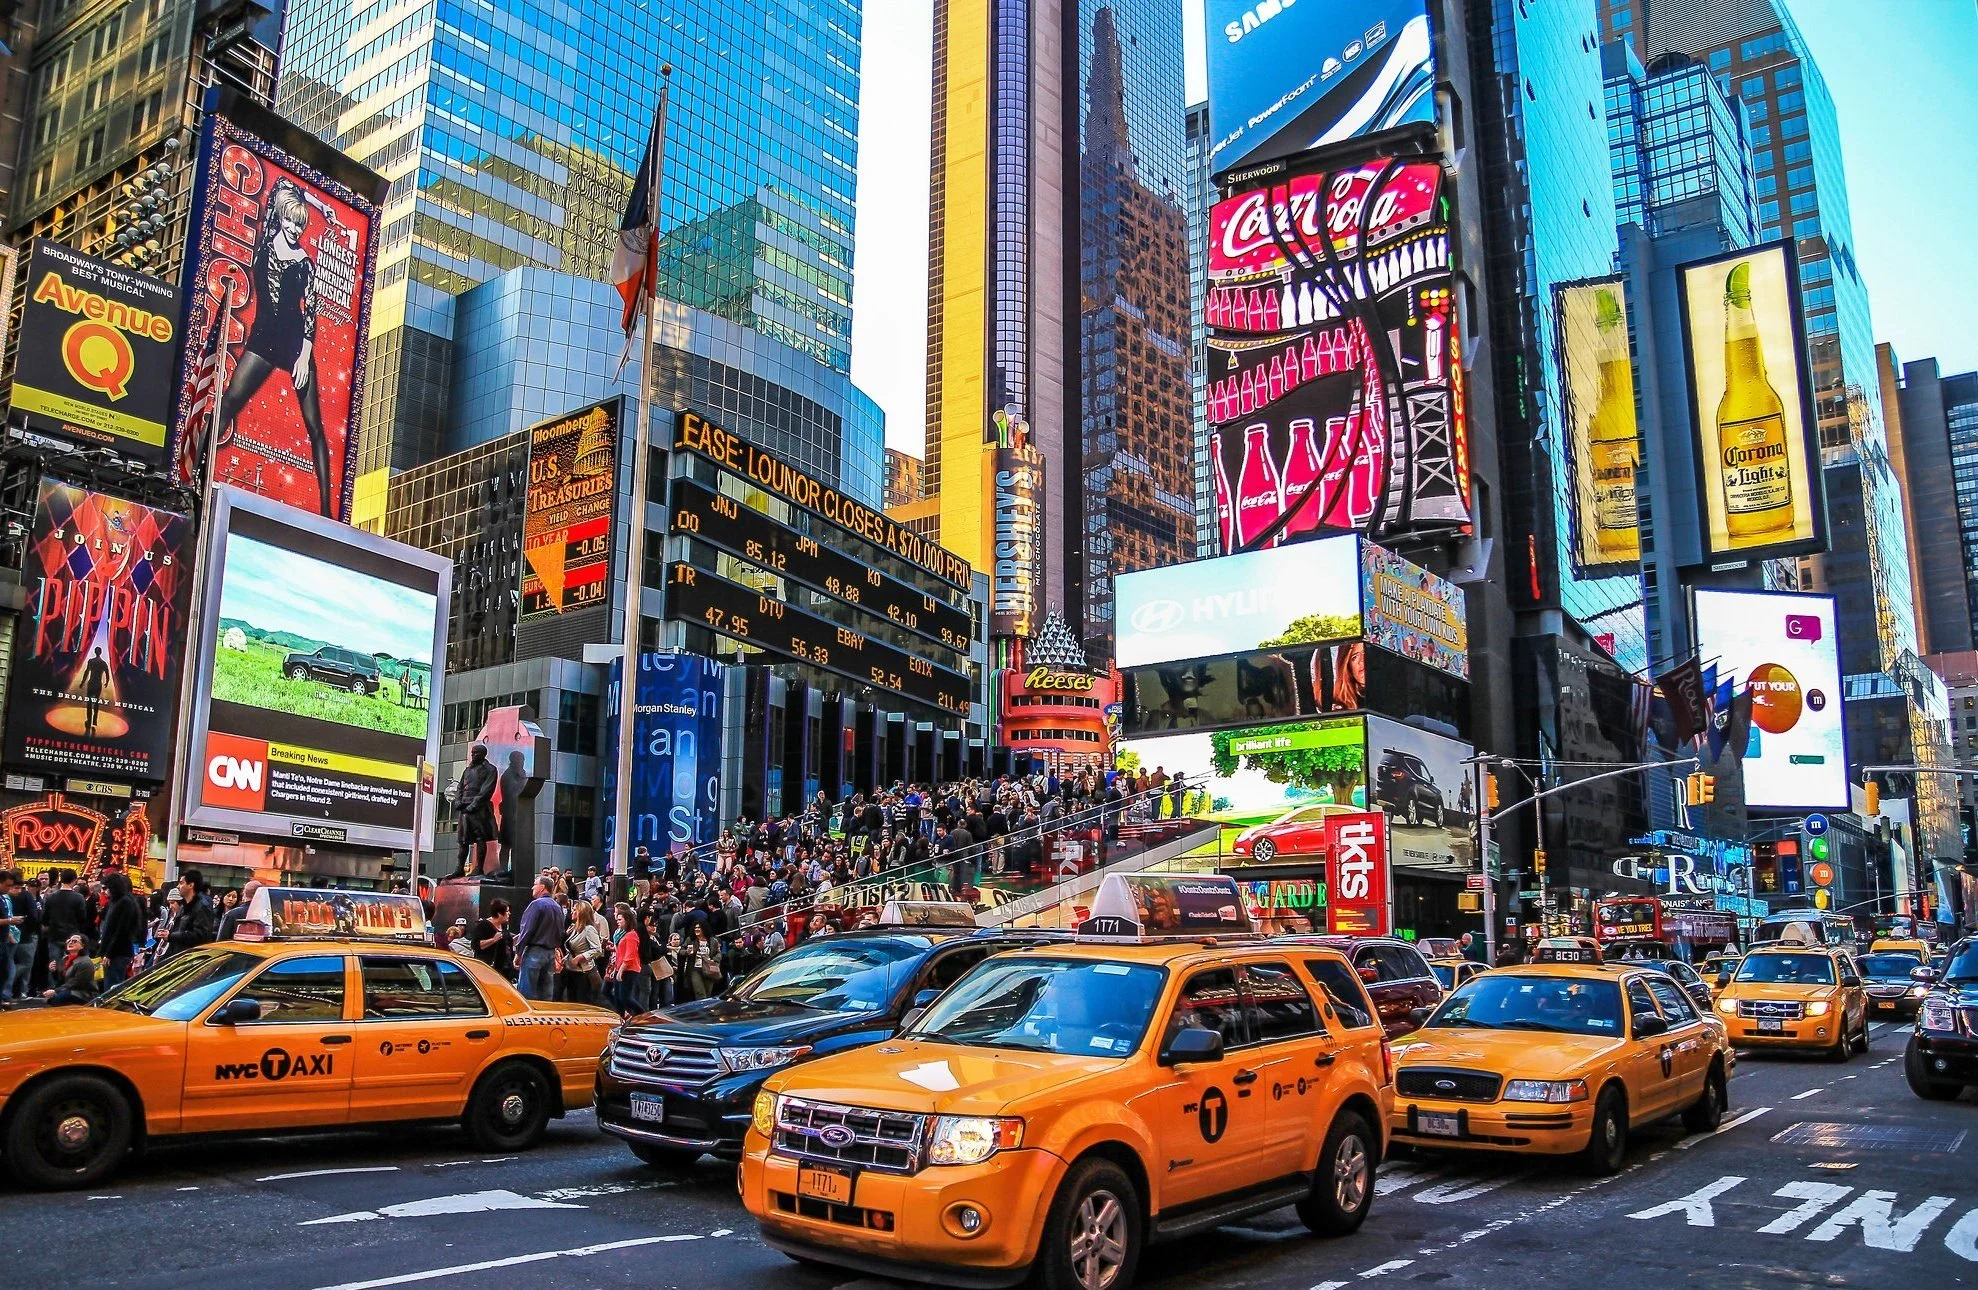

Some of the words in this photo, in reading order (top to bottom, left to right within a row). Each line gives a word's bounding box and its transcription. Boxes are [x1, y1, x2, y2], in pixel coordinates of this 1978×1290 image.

[1227, 164, 1280, 183] SHERWOOD
[43, 246, 104, 275] BROADWAY'S
[317, 250, 356, 283] RUNNING
[72, 266, 98, 281] BEST
[101, 277, 145, 298] MUSICAL
[313, 278, 351, 309] MUSICAL
[315, 264, 356, 295] AMERICAN
[34, 272, 173, 343] Avenue
[62, 319, 135, 402] Q
[40, 404, 96, 425] TELECHARGE.COM
[1449, 335, 1470, 499] SQUARE
[61, 424, 115, 443] AVENUEQ.COM
[533, 414, 591, 445] Bloomberg
[531, 455, 561, 484] U.S.
[1723, 442, 1786, 469] Corona
[675, 413, 743, 472] EASE:
[748, 447, 821, 513] LOUNOR
[824, 489, 884, 544] CLOSES
[886, 523, 897, 552] A
[1737, 465, 1774, 487] Light
[529, 472, 614, 513] TREASURIES
[549, 510, 569, 526] YIELD
[576, 498, 610, 517] CHANGE
[54, 529, 124, 555] JOIN
[143, 550, 173, 566] US
[576, 535, 605, 555] -0.05
[995, 467, 1033, 612] HERSHEY'S
[711, 494, 737, 520] JNJ
[746, 538, 787, 572] 85.12
[796, 534, 818, 558] JPM
[825, 575, 860, 604] 48.88
[867, 567, 881, 587] KO
[887, 603, 917, 630] 42.10
[923, 595, 936, 614] LH
[940, 628, 969, 651] 93.67
[573, 581, 602, 601] -0.04
[1379, 576, 1403, 603] MAKE
[1404, 588, 1412, 606] A
[1411, 590, 1446, 622] PLAYDATE
[28, 576, 170, 682] PIPPIN
[1381, 594, 1403, 620] WITH
[1404, 606, 1422, 630] YOUR
[1424, 615, 1441, 638] OWN
[1443, 623, 1461, 646] KIDS.
[1789, 620, 1803, 634] G
[704, 606, 749, 638] 47.95
[759, 595, 785, 621] DTV
[791, 637, 829, 666] 56.33
[837, 627, 865, 652] EBAY
[871, 666, 902, 692] 52.54
[909, 654, 933, 679] EQIX
[938, 691, 970, 716] 211.49
[1024, 666, 1095, 690] Reese's
[1767, 681, 1796, 692] YOUR
[33, 688, 53, 697] THE
[57, 692, 110, 706] BROADWAY
[114, 701, 155, 713] MUSICAL
[663, 703, 697, 717] Stanley
[1813, 696, 1823, 705] m
[25, 746, 91, 760] TELECHARGE.COM
[30, 754, 53, 762] MUSIC
[271, 747, 306, 763] Breaking
[306, 753, 329, 765] News
[1235, 737, 1273, 752] brilliant
[1274, 737, 1292, 748] life
[208, 754, 263, 792] CNN
[272, 769, 289, 780] Manti
[306, 775, 323, 786] Notre
[323, 778, 340, 788] Dame
[340, 780, 369, 793] linebacker
[370, 784, 393, 796] involved
[393, 788, 398, 797] in
[398, 788, 412, 799] hoax
[95, 784, 113, 793] CBS
[271, 789, 299, 803] Chargers
[300, 793, 306, 801] in
[325, 796, 332, 805] 2.
[272, 779, 285, 789] that
[285, 782, 310, 793] included
[310, 785, 344, 798] nonexistent
[344, 790, 371, 803] girlfriend,
[371, 793, 389, 804] drafted
[390, 796, 398, 806] by
[1674, 777, 1694, 831] R
[13, 815, 93, 853] ROXY
[1810, 820, 1822, 829] m
[1340, 820, 1376, 899] tkts
[1664, 854, 1711, 896] R
[283, 900, 336, 925] IRON
[356, 904, 395, 929] MAN
[399, 905, 412, 929] 3
[1094, 919, 1120, 933] 1T71
[1555, 951, 1580, 961] 8C30
[215, 1064, 259, 1080] NYC
[262, 1050, 333, 1079] TAXI
[1183, 1102, 1199, 1114] NYC
